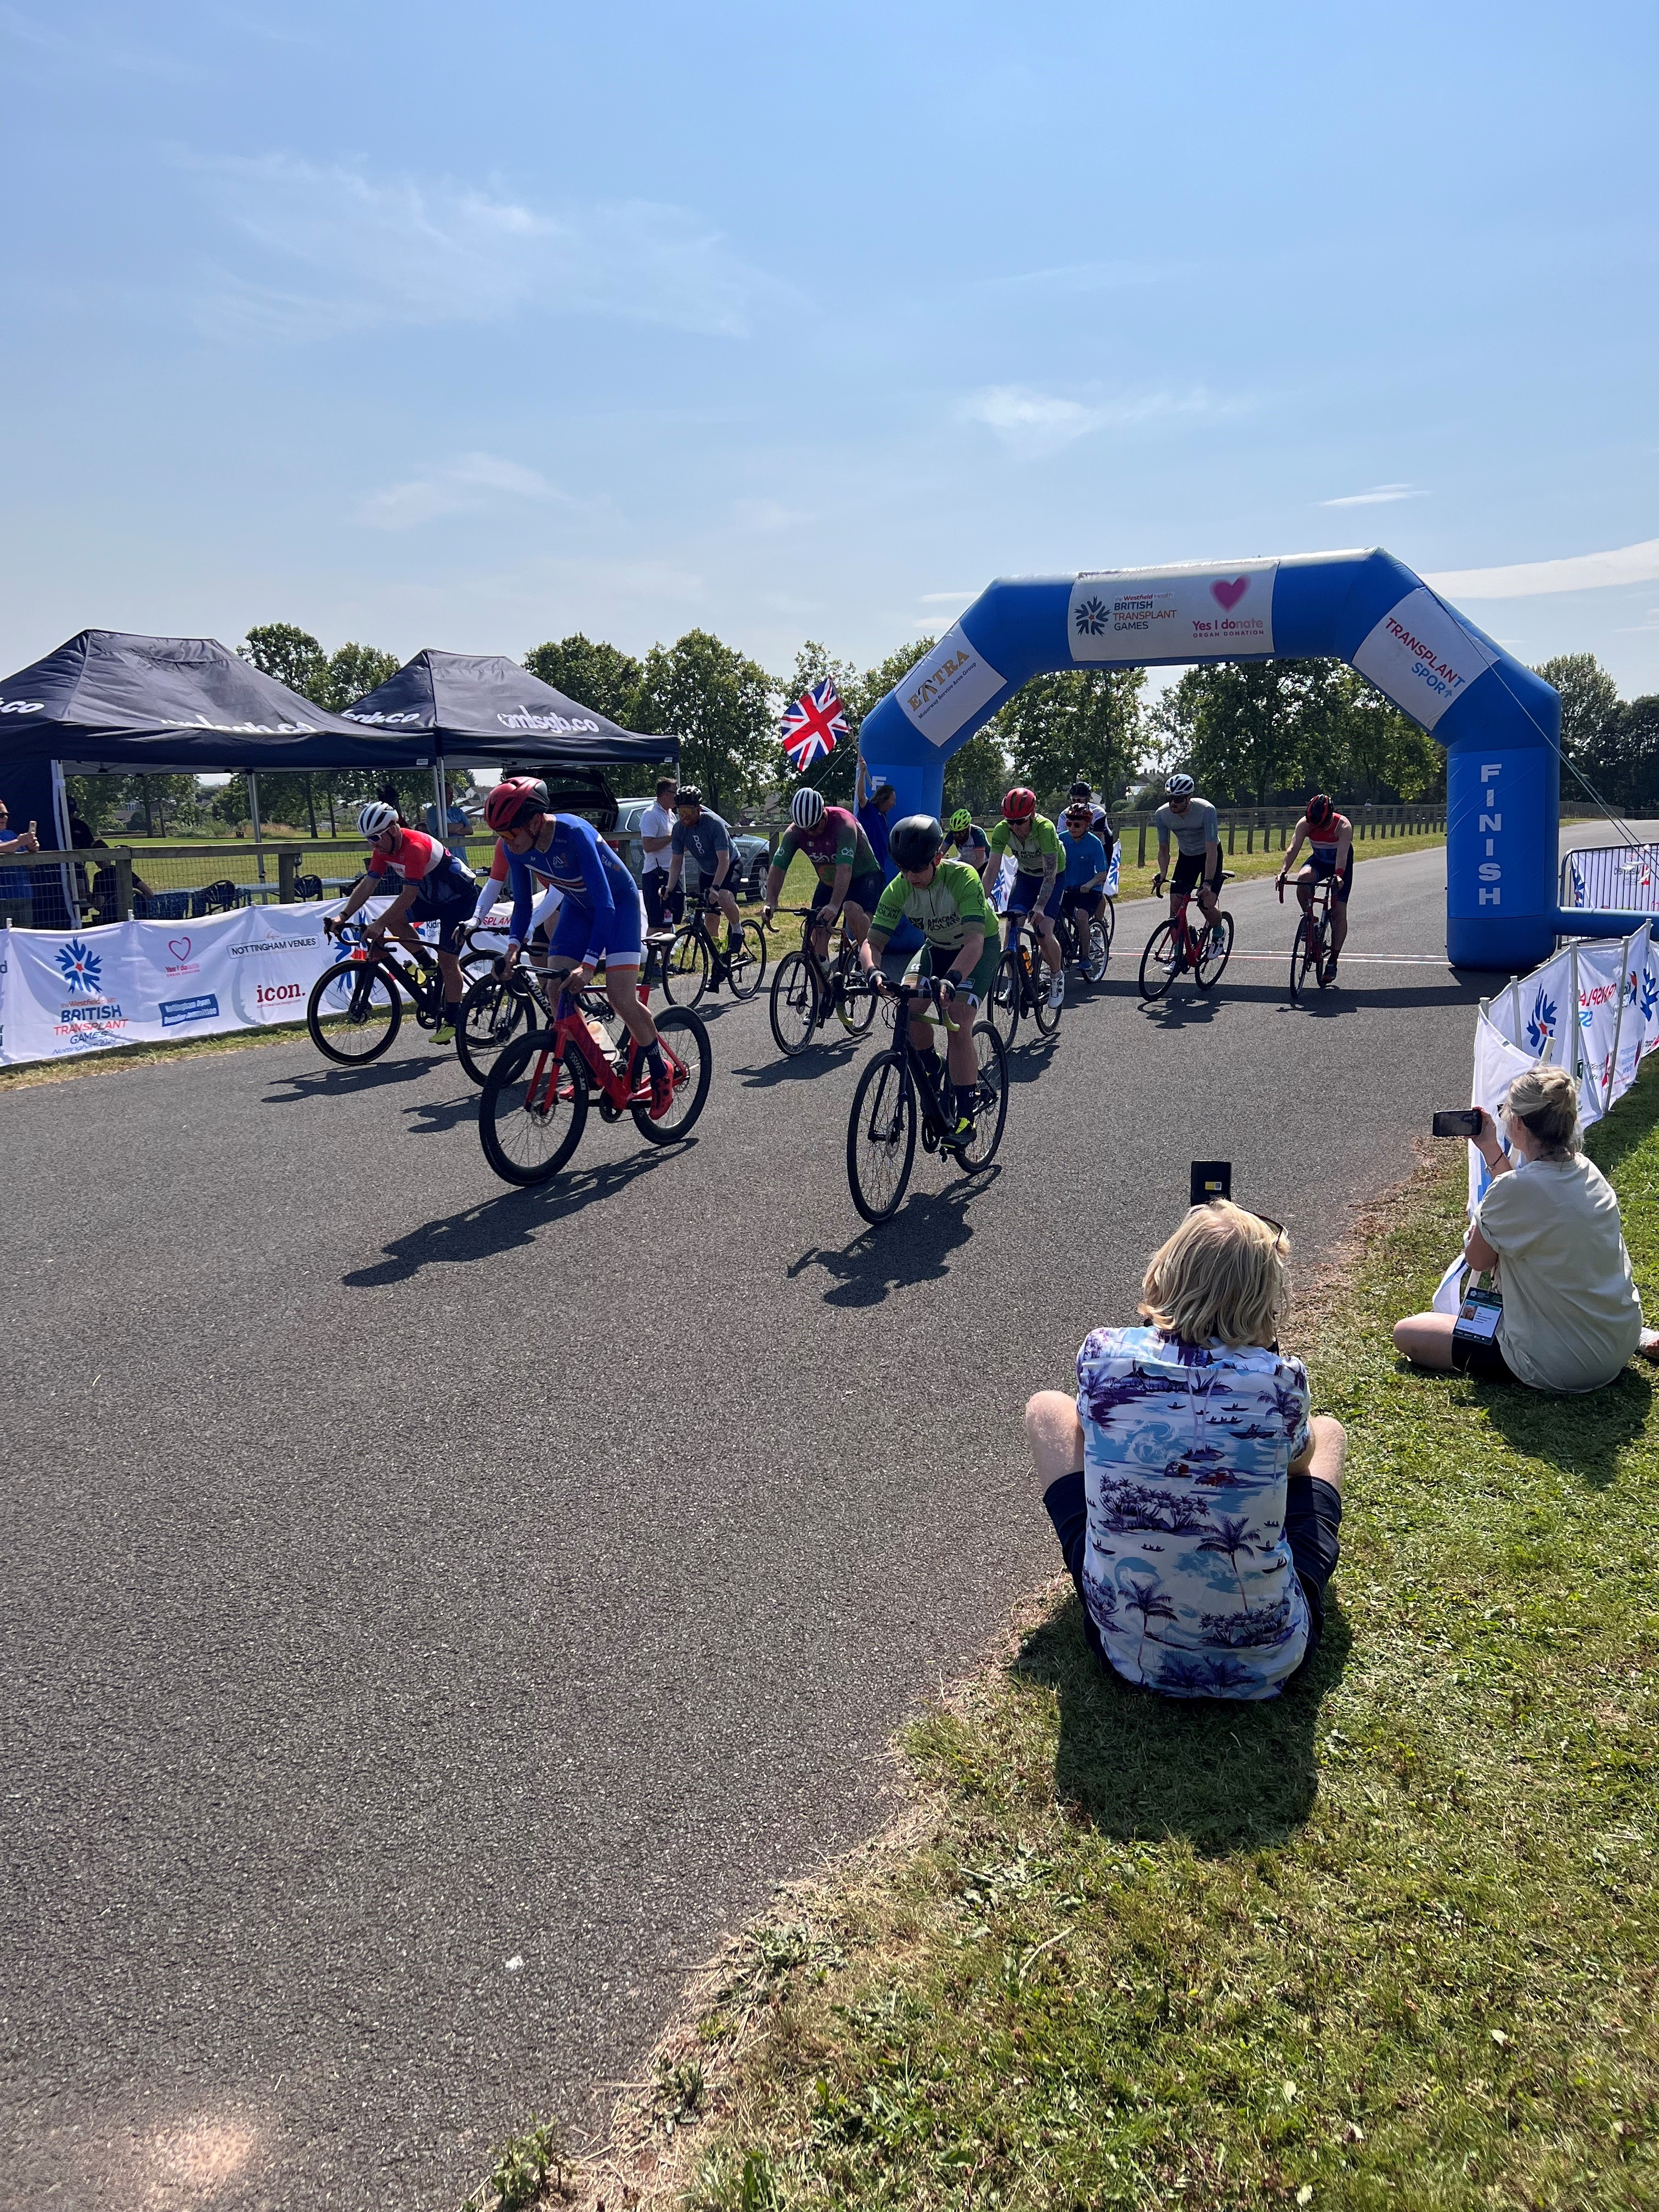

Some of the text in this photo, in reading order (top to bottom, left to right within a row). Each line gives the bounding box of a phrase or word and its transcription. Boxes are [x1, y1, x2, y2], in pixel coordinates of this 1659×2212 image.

[1114, 600, 1153, 611] BRITISH
[1124, 593, 1153, 601] Westfield
[1113, 610, 1177, 621] TRANSPLANT
[1114, 621, 1149, 631] GAMES
[1192, 618, 1263, 631] Yes I donate
[1385, 617, 1465, 688] TRANSPLANT
[918, 662, 977, 720] Motorway Service Area Group
[1478, 763, 1502, 906] FINISH
[692, 834, 705, 855] POC
[231, 941, 287, 955] NOTTINGHAM
[287, 938, 316, 948] VENUES
[256, 983, 306, 1003] icon.
[61, 1005, 122, 1023] BRITISH
[53, 1019, 129, 1036] TRANSPLANT
[70, 1031, 109, 1044] GAMES
[569, 1052, 583, 1076] SWISS
